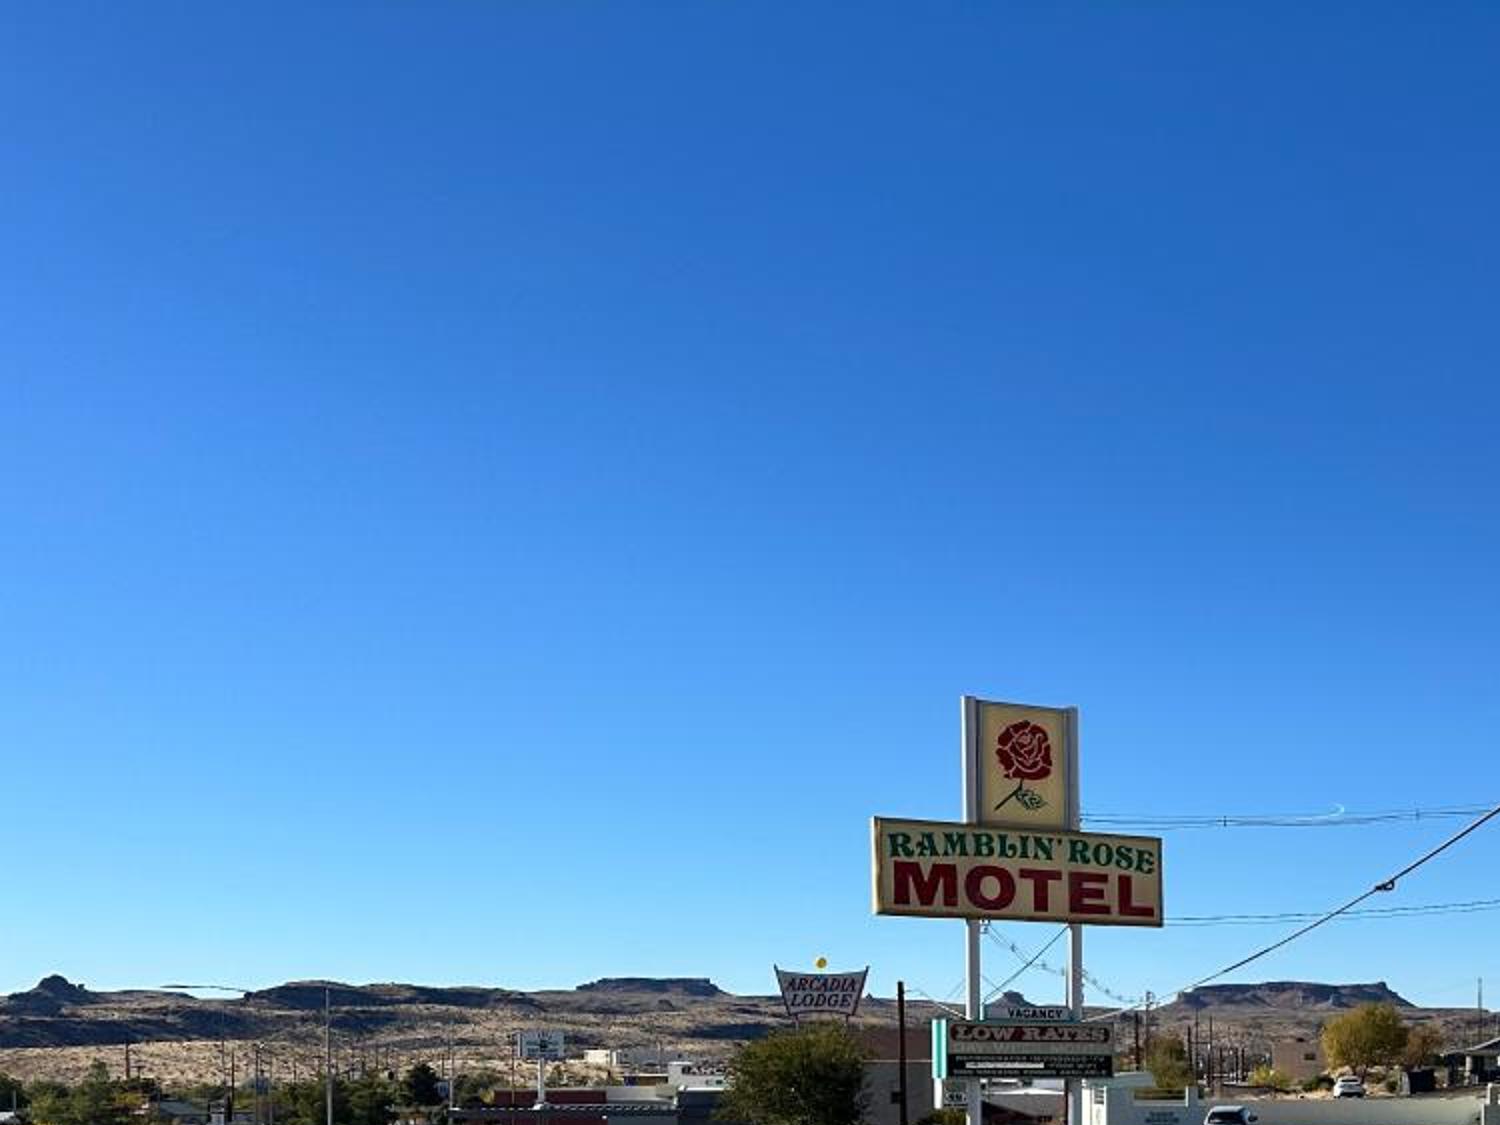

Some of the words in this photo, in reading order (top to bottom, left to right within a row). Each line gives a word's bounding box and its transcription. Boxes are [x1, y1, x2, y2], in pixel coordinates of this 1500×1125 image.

[888, 831, 1062, 861] RAMBLIN'
[1067, 838, 1155, 875] ROSE
[892, 859, 1155, 918] MOTEL
[783, 977, 857, 993] ARCADIA
[789, 993, 854, 1008] LODGE
[1007, 1007, 1064, 1019] VACANCY
[955, 1026, 1016, 1041] LOW
[1020, 1026, 1107, 1041] RATES
